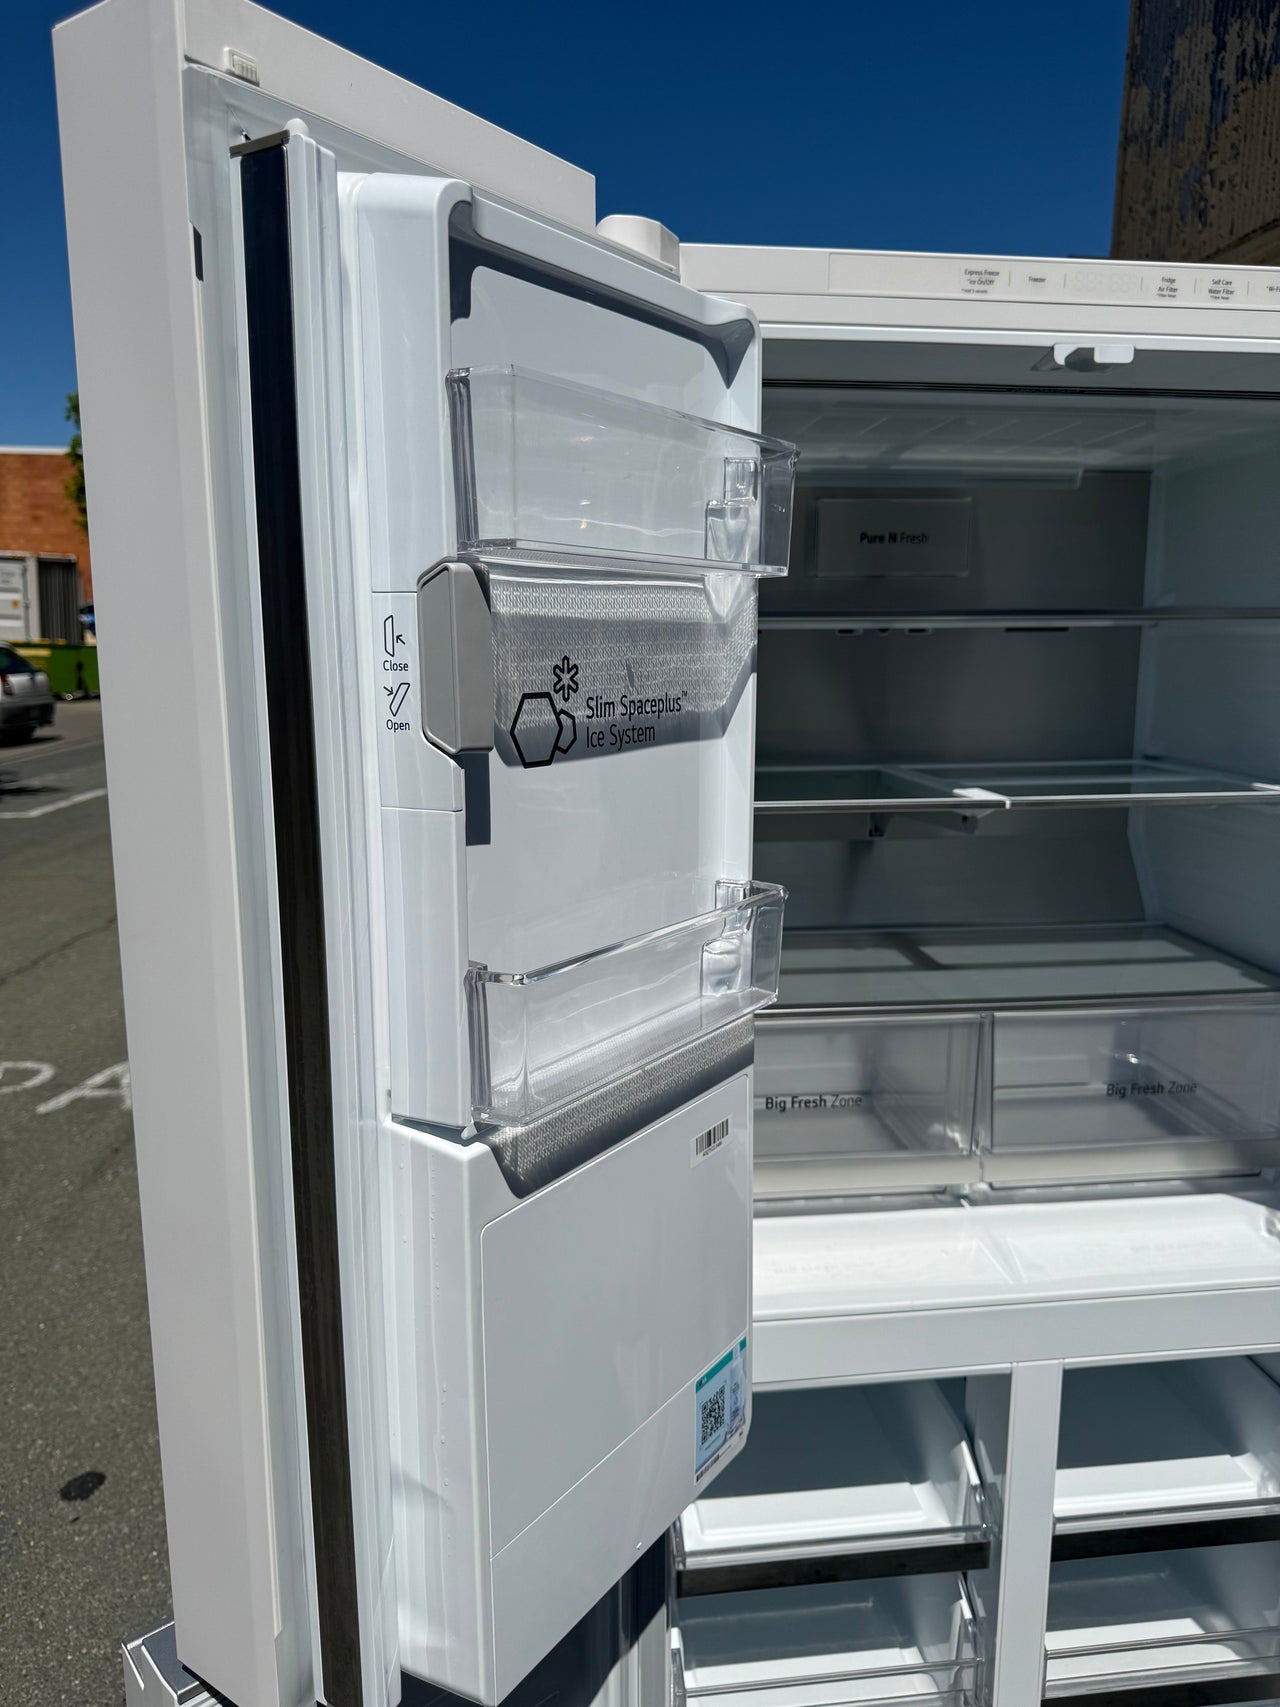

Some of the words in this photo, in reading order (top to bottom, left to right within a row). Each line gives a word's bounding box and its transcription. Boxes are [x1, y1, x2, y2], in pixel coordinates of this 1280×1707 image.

[964, 268, 983, 277] Express
[1161, 276, 1176, 284] Fridge
[1211, 278, 1221, 286] Self
[1208, 287, 1222, 295] Water
[859, 532, 885, 544] Pure
[888, 532, 897, 544] N
[900, 532, 928, 544] Fresh
[383, 660, 409, 672] Close
[586, 695, 616, 719] Slim
[386, 719, 411, 733] Open
[586, 726, 605, 748] Ice
[609, 723, 656, 751] System
[1106, 1083, 1126, 1098] Big
[1130, 1081, 1164, 1096] Fresh
[1168, 1081, 1198, 1095] Zone
[765, 1096, 786, 1112] Big
[791, 1094, 827, 1108] Fresh
[831, 1093, 863, 1108] Zone
